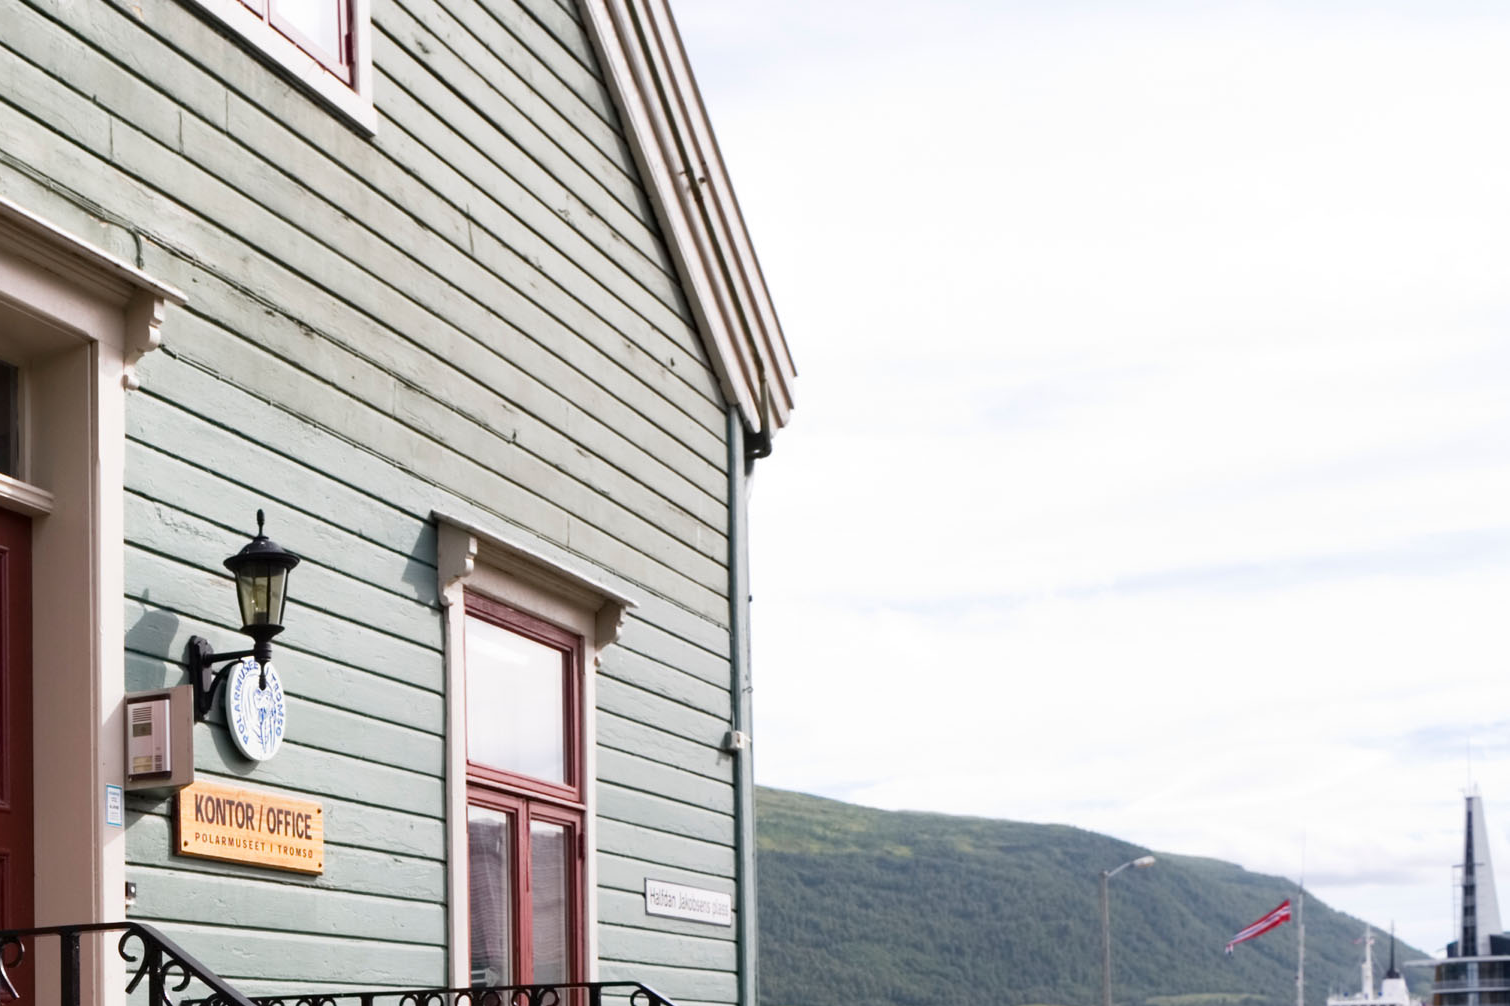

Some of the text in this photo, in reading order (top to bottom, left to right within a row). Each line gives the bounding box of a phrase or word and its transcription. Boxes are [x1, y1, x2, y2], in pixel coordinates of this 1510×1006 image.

[233, 659, 260, 745] POLARMUSEE
[194, 793, 313, 841] KONTOR / OFFICE
[194, 832, 265, 852] POLARMUSEET
[649, 887, 676, 909] Halfdan
